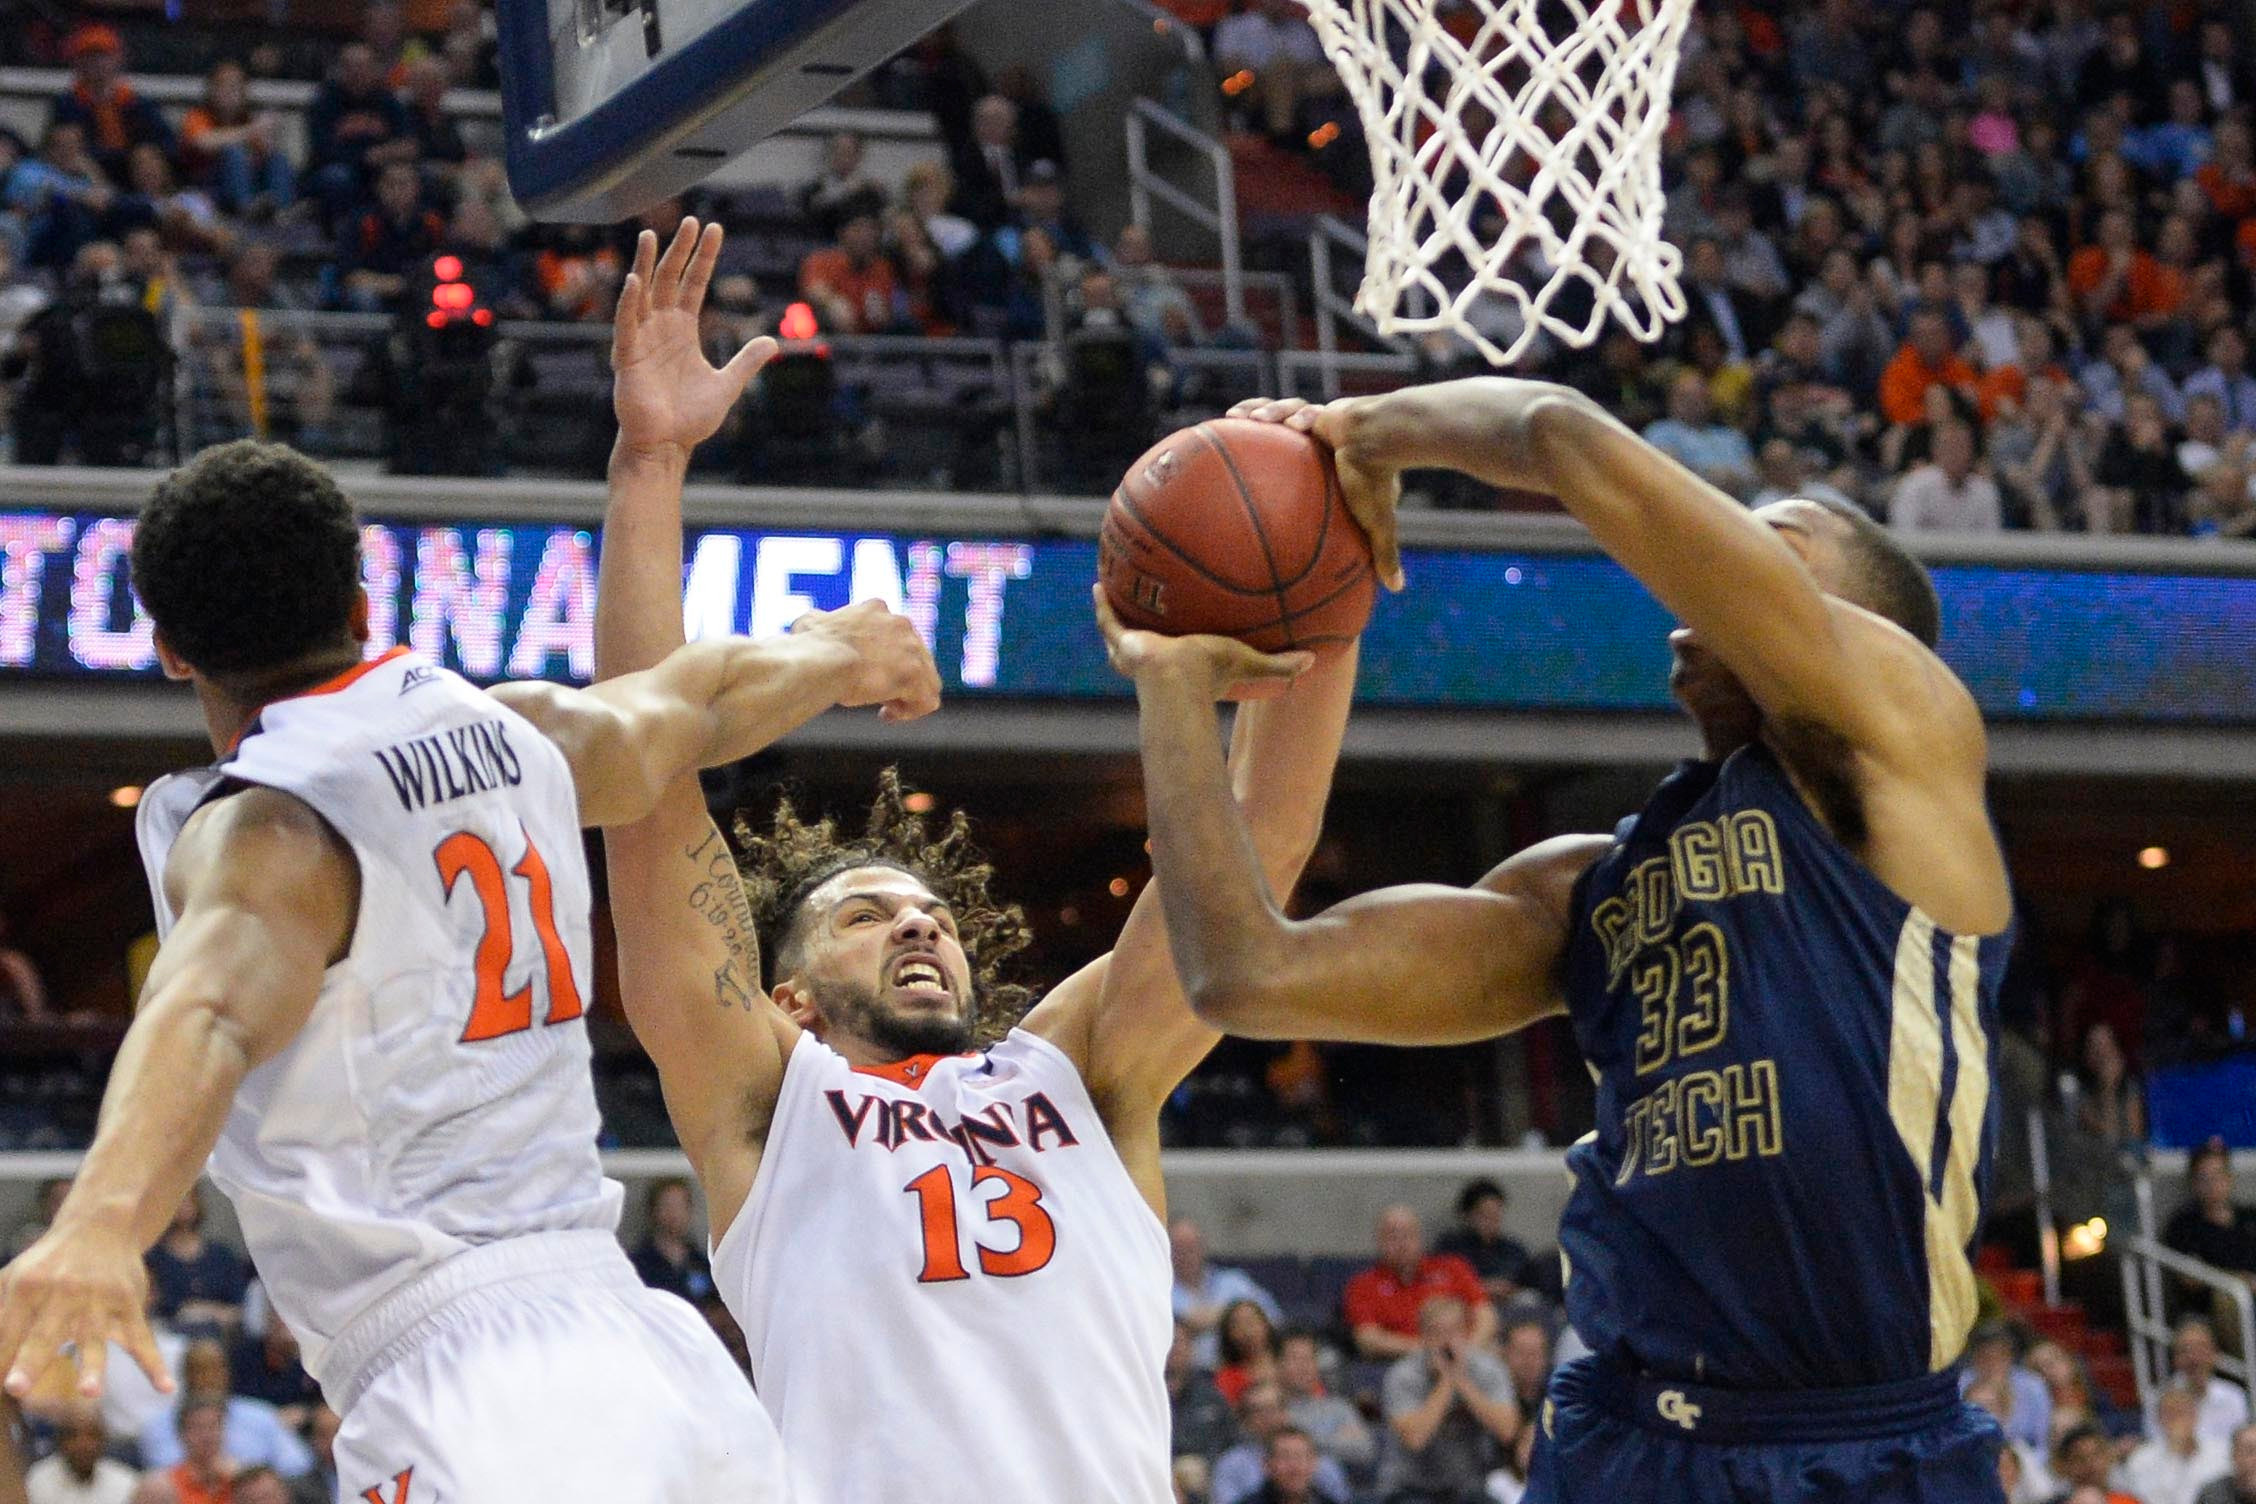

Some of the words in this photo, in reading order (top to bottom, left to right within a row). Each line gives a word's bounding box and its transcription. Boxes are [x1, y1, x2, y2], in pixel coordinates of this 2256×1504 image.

[373, 720, 521, 812] WILKINS
[434, 818, 582, 1043] 21
[1632, 922, 1730, 1076] 33
[1615, 1059, 1783, 1187] TECH
[903, 1163, 1056, 1283] 13
